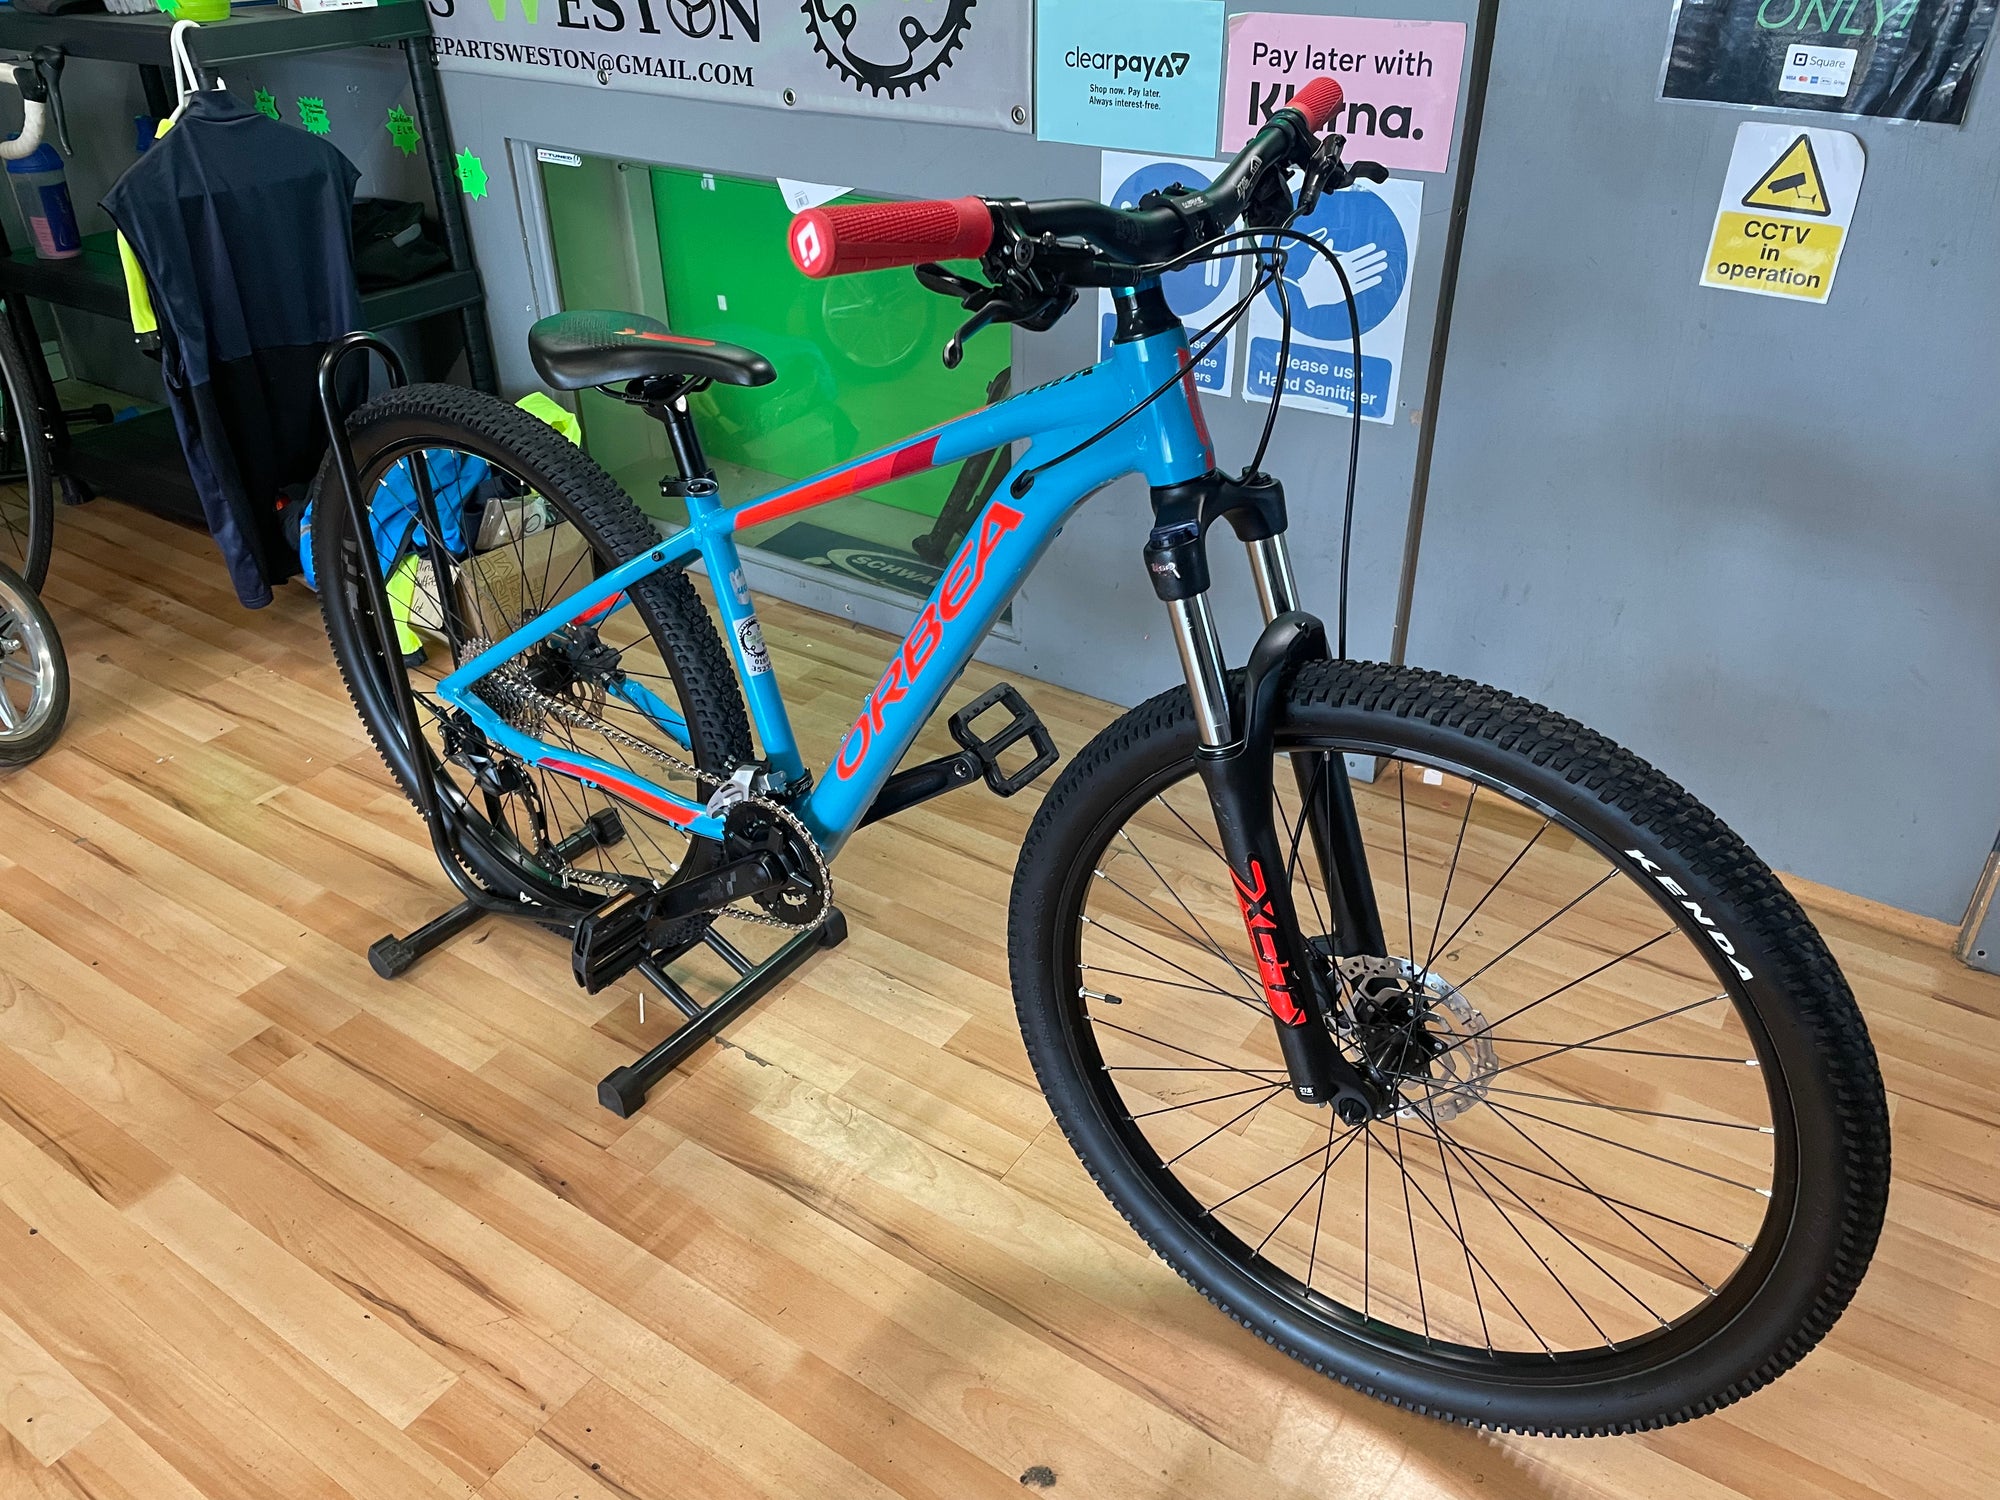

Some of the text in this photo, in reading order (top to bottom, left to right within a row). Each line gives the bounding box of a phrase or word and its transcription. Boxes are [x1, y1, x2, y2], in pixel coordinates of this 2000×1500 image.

[1065, 46, 1156, 82] clearpay
[1252, 42, 1433, 77] Pay later with
[1810, 56, 1846, 68] Square
[1089, 84, 1161, 98] Shop now. Pay later.
[1089, 96, 1161, 110] Always interest-free.
[1744, 220, 1811, 244] CCTV
[1760, 243, 1780, 262] in
[1716, 261, 1821, 289] operation
[1258, 370, 1378, 405] Hand Sanitiser
[837, 501, 1024, 780] ORBEA
[1624, 850, 1754, 981] KENDA
